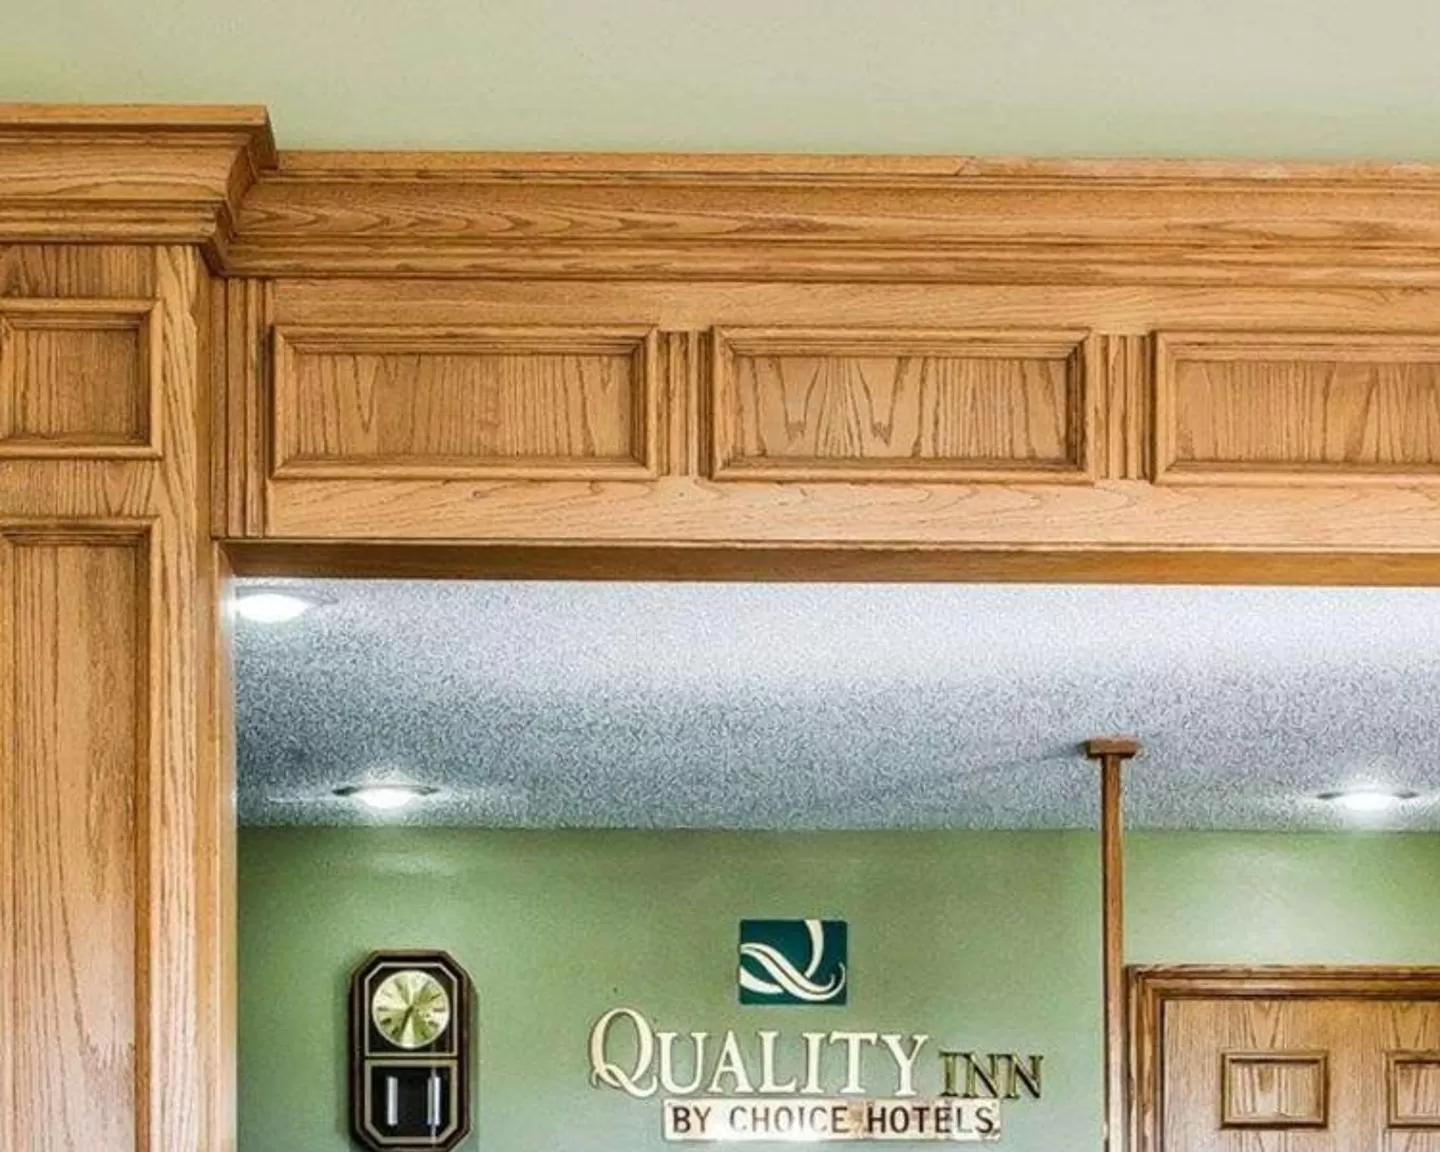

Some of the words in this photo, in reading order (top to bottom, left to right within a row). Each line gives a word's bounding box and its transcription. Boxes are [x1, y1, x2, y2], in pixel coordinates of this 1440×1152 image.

[588, 1006, 929, 1098] QUALITY
[938, 1048, 1044, 1100] INN
[672, 1106, 712, 1133] BY
[728, 1106, 849, 1134] CHOICE
[867, 1106, 994, 1134] HOTELS
